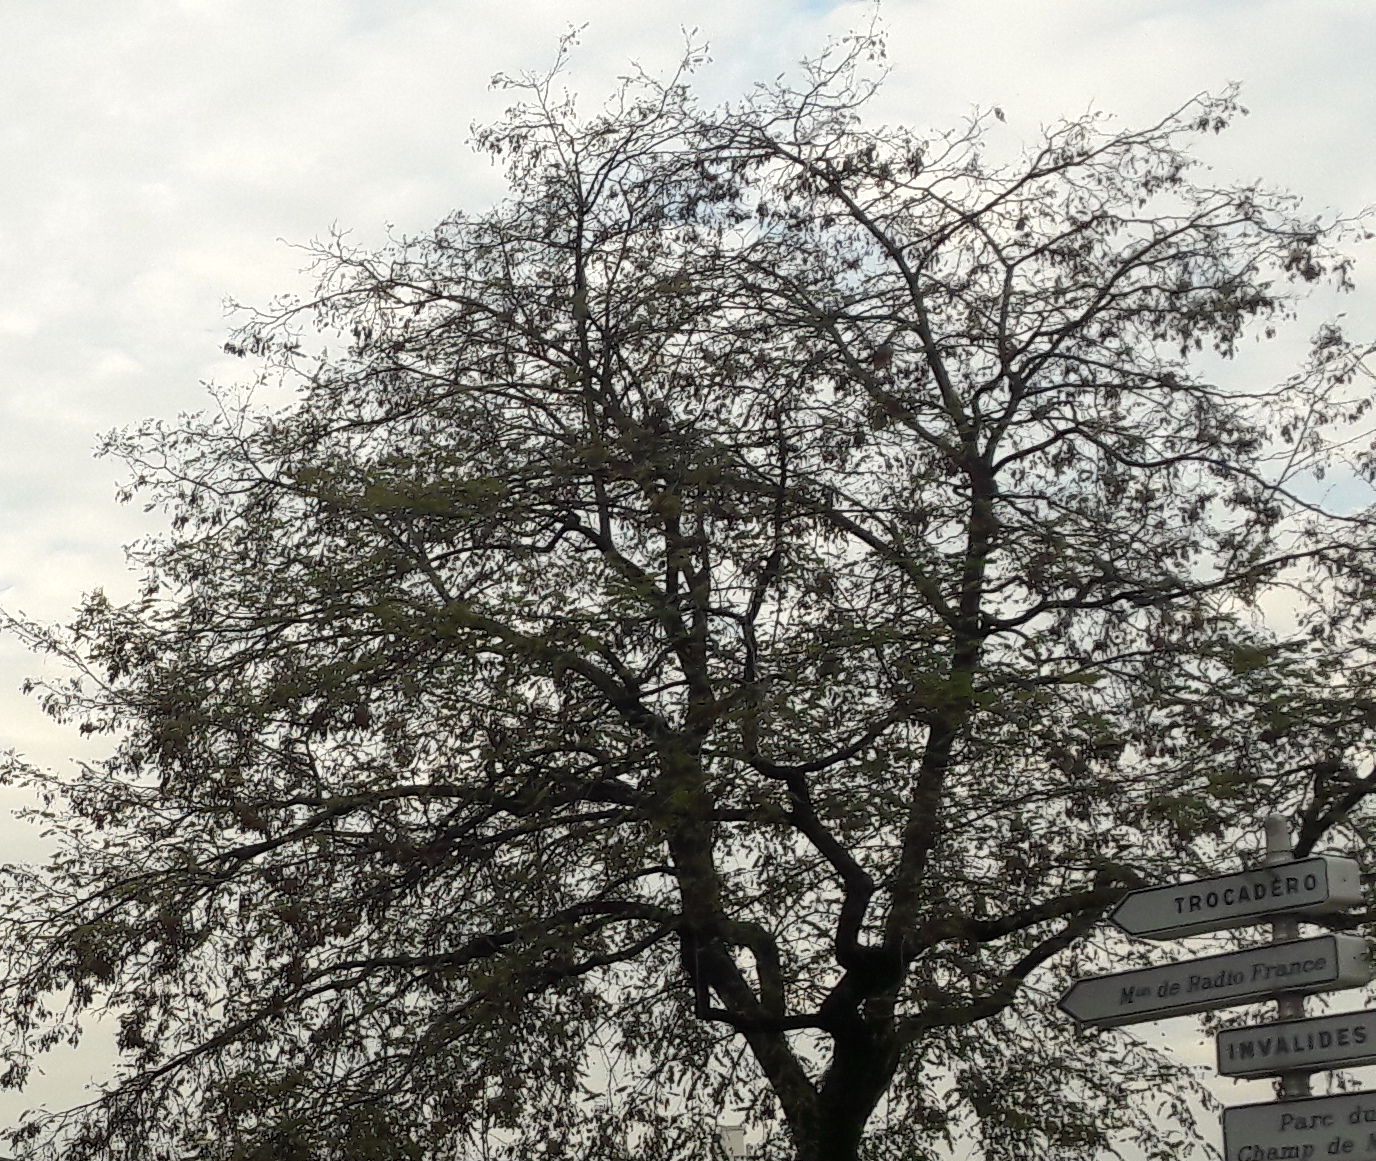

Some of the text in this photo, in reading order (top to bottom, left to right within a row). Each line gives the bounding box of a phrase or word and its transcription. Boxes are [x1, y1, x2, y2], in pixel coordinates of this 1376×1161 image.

[1157, 980, 1180, 997] de
[1186, 970, 1244, 993] Radio
[1250, 957, 1327, 982] France
[1228, 1026, 1367, 1060] INVALIDES
[1279, 1105, 1376, 1132] Parc du
[1328, 1136, 1354, 1154] de
